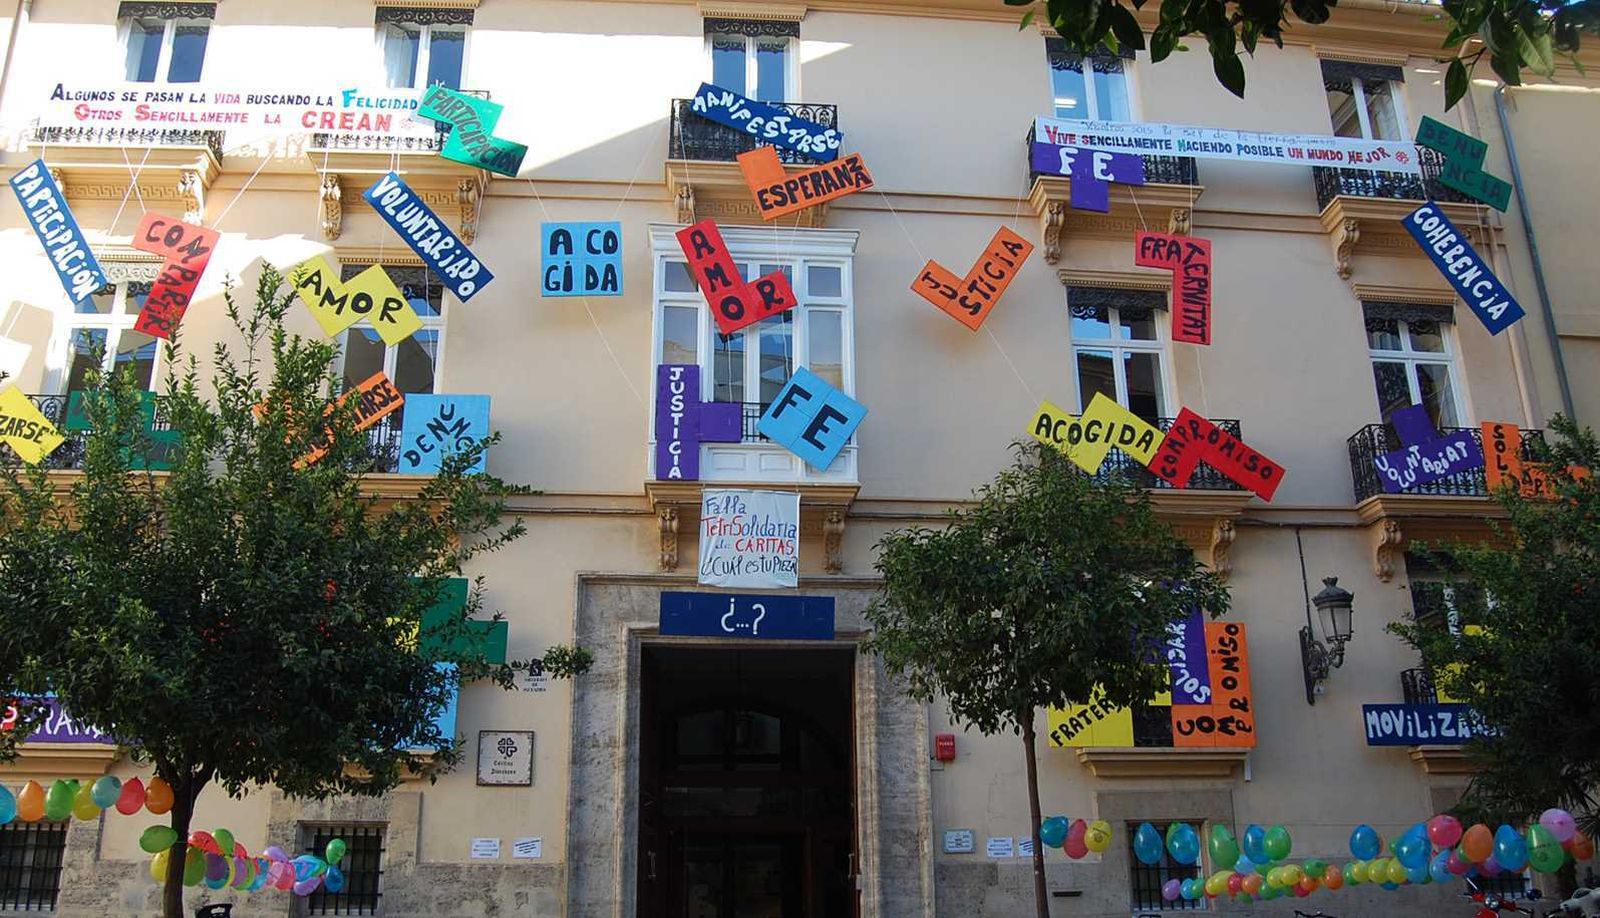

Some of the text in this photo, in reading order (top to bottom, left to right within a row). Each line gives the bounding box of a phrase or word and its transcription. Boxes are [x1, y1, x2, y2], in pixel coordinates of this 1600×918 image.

[51, 83, 418, 110] ALGUNOS SE PASAN LA VIDA BUSCANDO LA FELICIDAD
[74, 103, 392, 132] OTROS SENCILLAMENTE LA CREAN
[1044, 124, 1391, 164] VIVE SENCILLAMENTE HACIENDO POSIBLE UN MUNDO MEJOR
[1059, 147, 1115, 181] FE
[757, 157, 873, 211] ESPERANZA
[300, 269, 404, 323] AMOR
[690, 229, 784, 321] AMOR
[668, 367, 685, 479] JUSTICIA
[771, 383, 848, 451] FE
[1035, 412, 1155, 454] ACOGIDA
